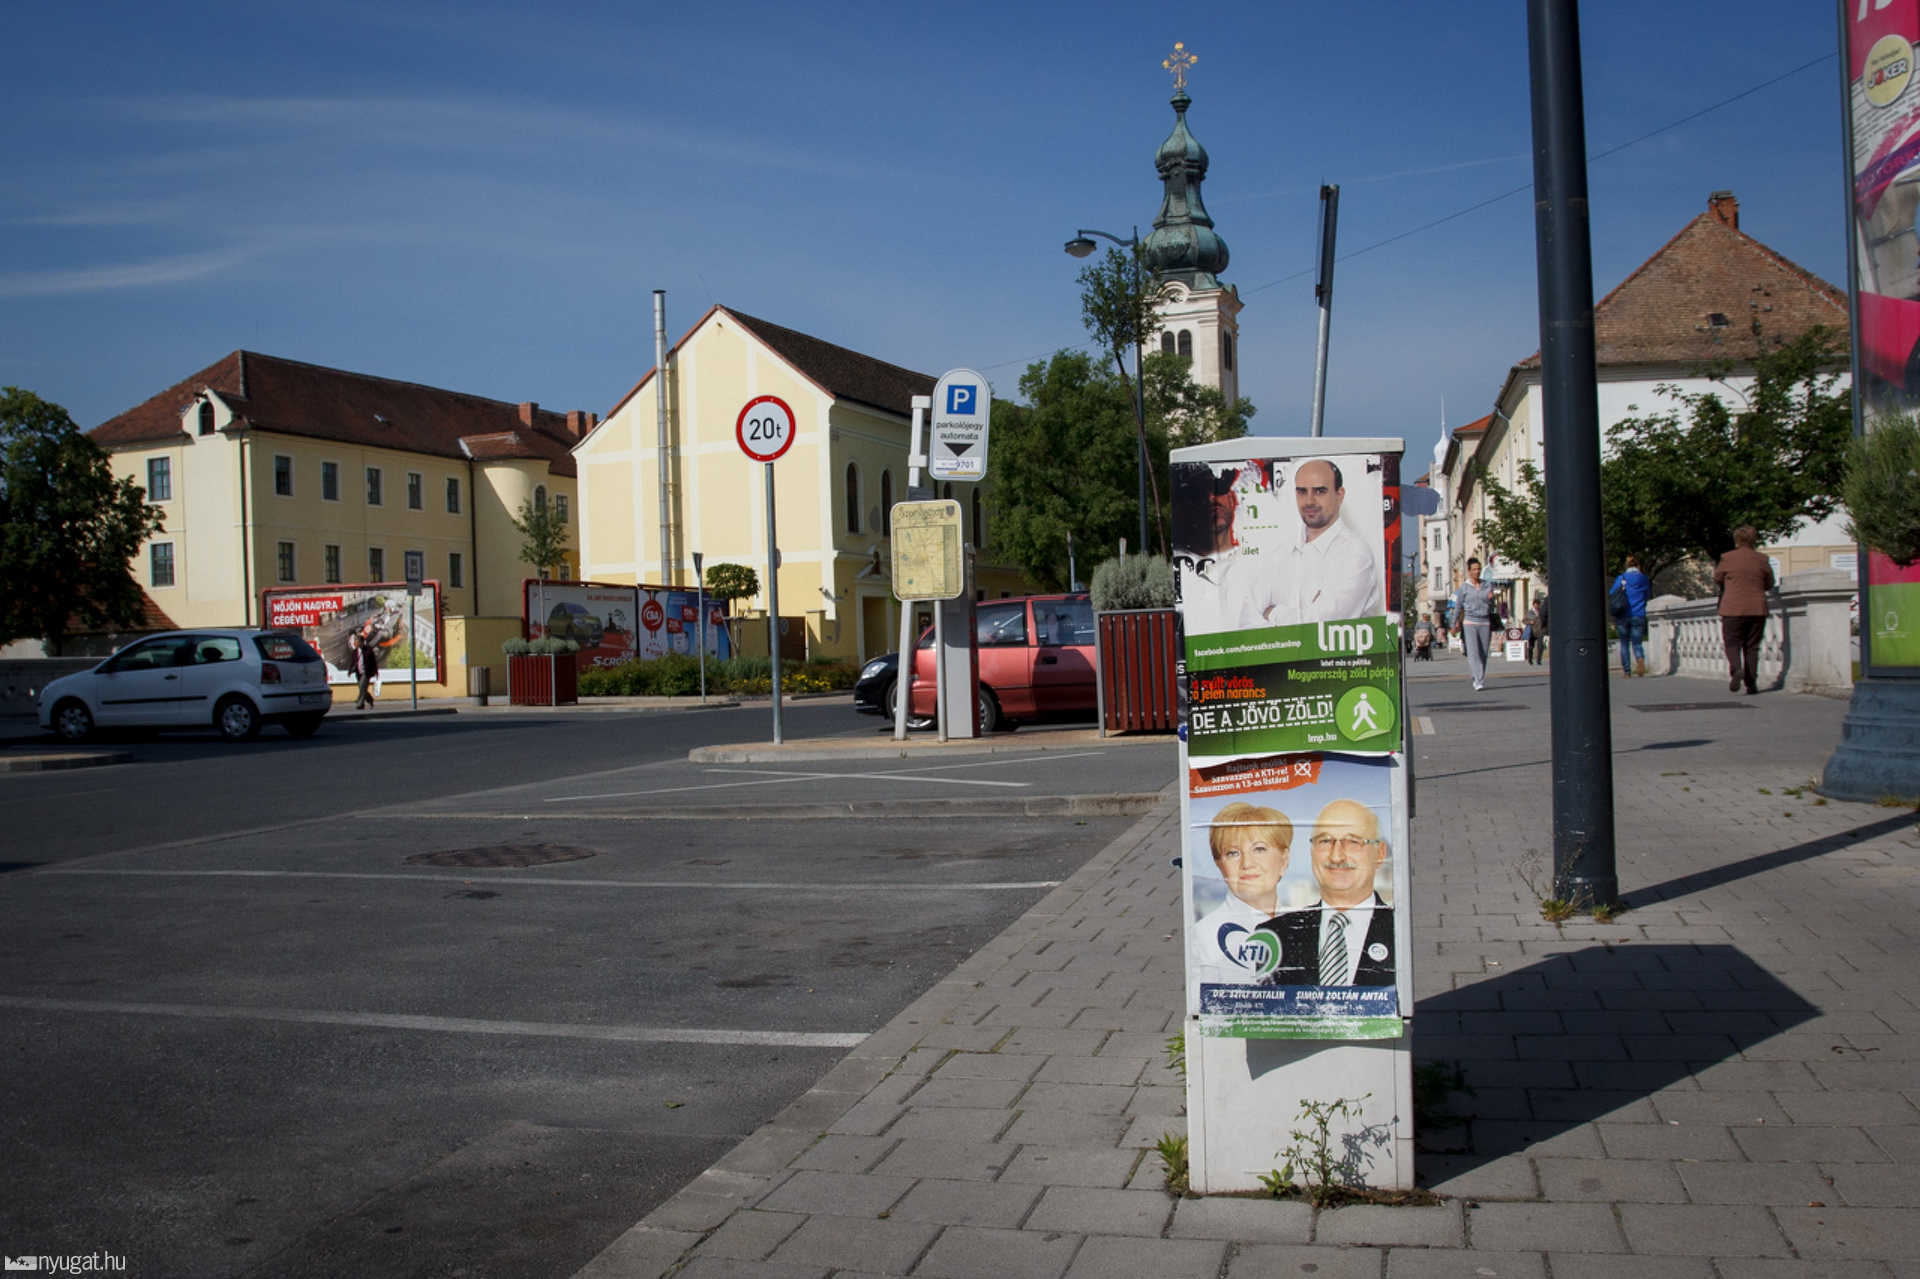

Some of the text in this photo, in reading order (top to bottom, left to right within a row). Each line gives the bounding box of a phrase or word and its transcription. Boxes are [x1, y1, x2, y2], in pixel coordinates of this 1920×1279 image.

[953, 388, 970, 411] P
[936, 421, 984, 431] parkolójegy
[940, 432, 979, 440] automata
[303, 599, 338, 611] NAGYRA
[273, 614, 314, 625] CÉGÉVEL!
[1318, 620, 1374, 655] lmp
[1288, 667, 1394, 682] Magyarország zöld pártja
[1192, 688, 1266, 703] a jelen narancs
[1192, 700, 1334, 730] DE A JÖVŐ ZÖLD!
[1307, 732, 1337, 744] lmp.hu
[1211, 773, 1254, 784] Szavazzon
[1261, 767, 1288, 777] KTI-re!
[1194, 782, 1234, 793] Szavazzon
[1242, 779, 1262, 788] 13-as
[1263, 775, 1289, 785] listára!
[1238, 945, 1264, 961] KTI
[1295, 989, 1389, 1000] SIMON ZOLTÁN ANTAL
